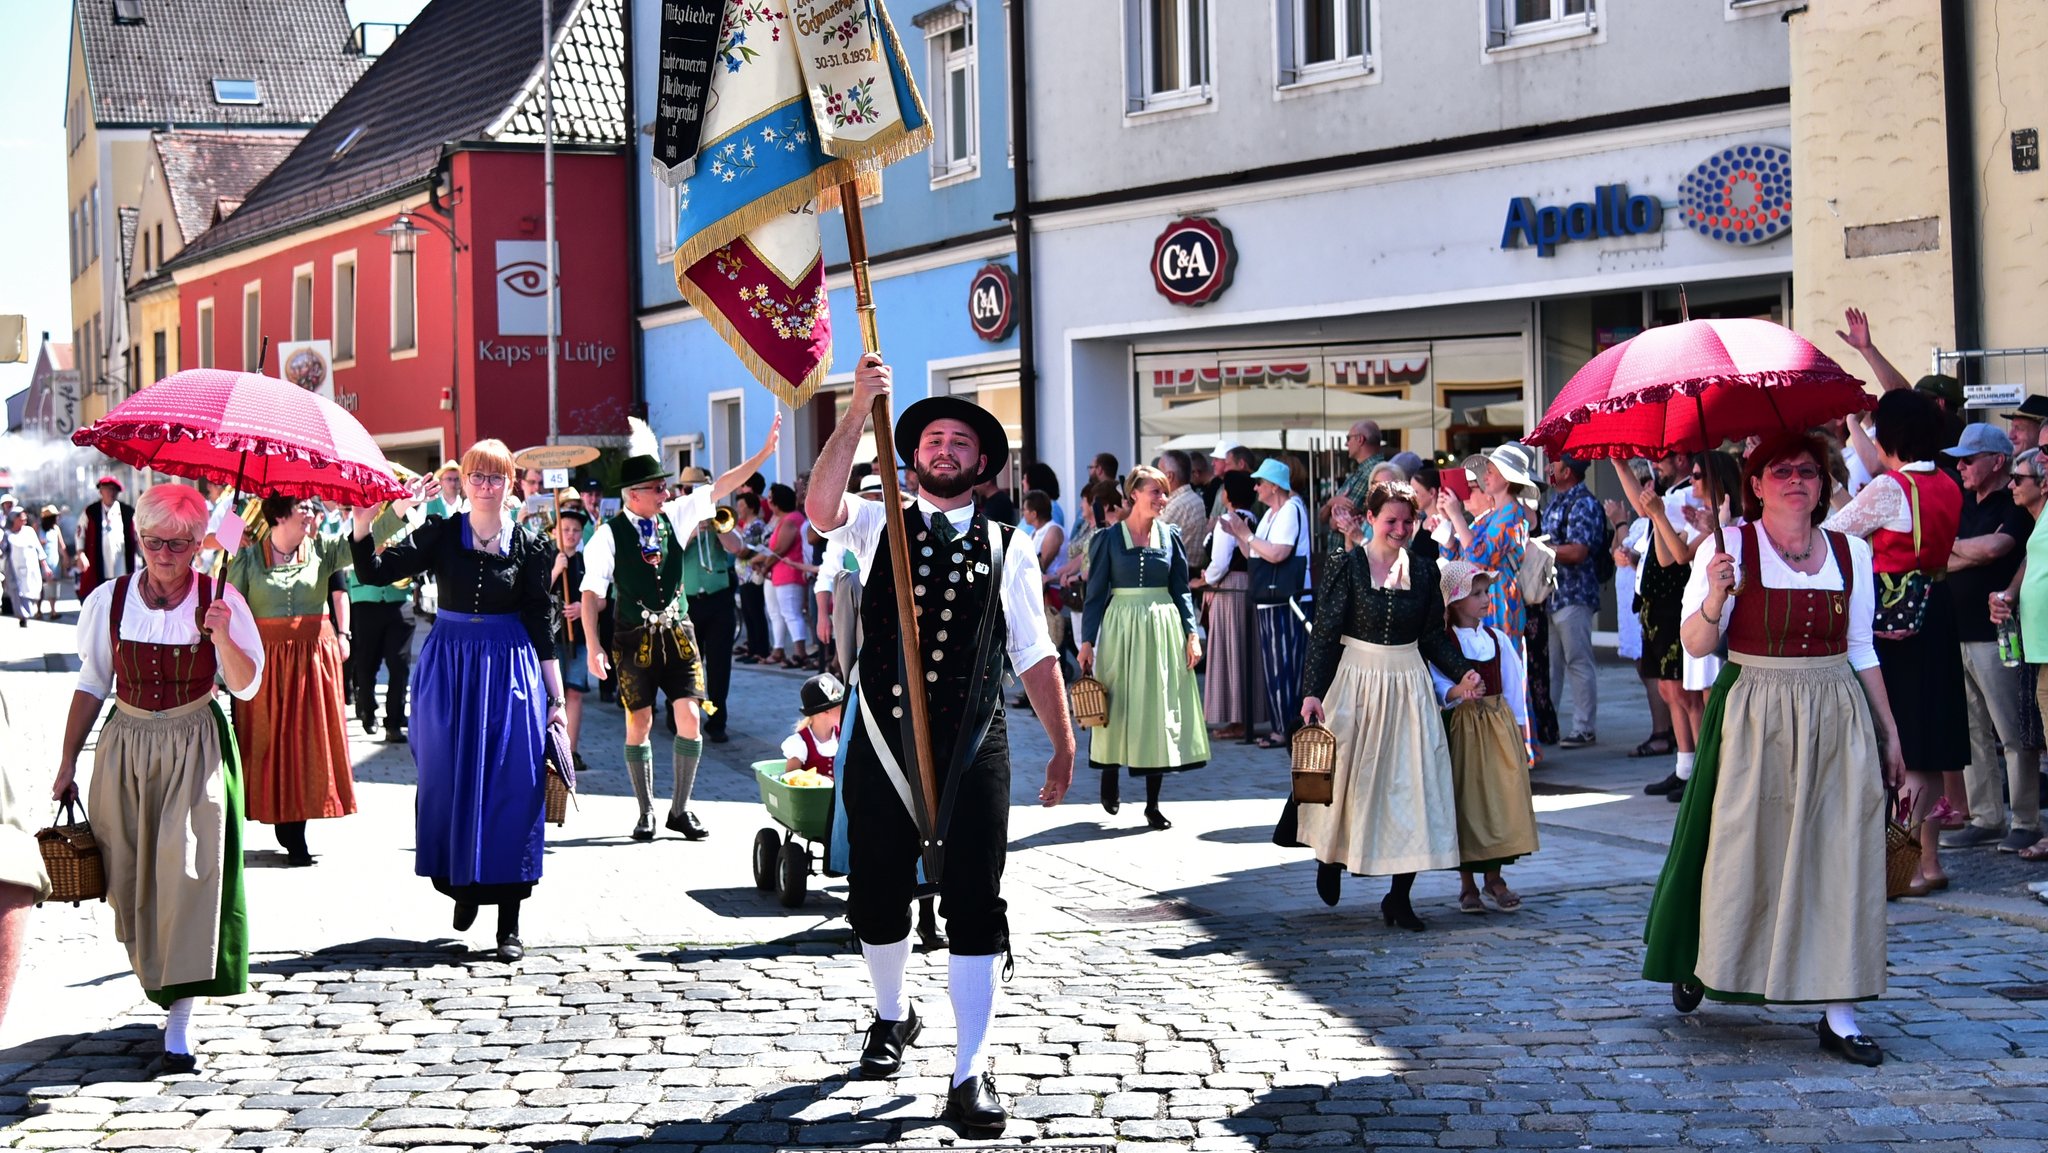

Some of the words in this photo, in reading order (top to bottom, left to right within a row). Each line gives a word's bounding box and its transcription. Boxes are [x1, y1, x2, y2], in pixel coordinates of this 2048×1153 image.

[665, 3, 715, 25] Mitglieder
[1500, 183, 1662, 258] Apollo
[1162, 241, 1210, 281] C&A
[973, 285, 1000, 319] C&A
[479, 340, 531, 367] Kaps
[564, 340, 616, 368] Lütje
[550, 473, 563, 483] 45
